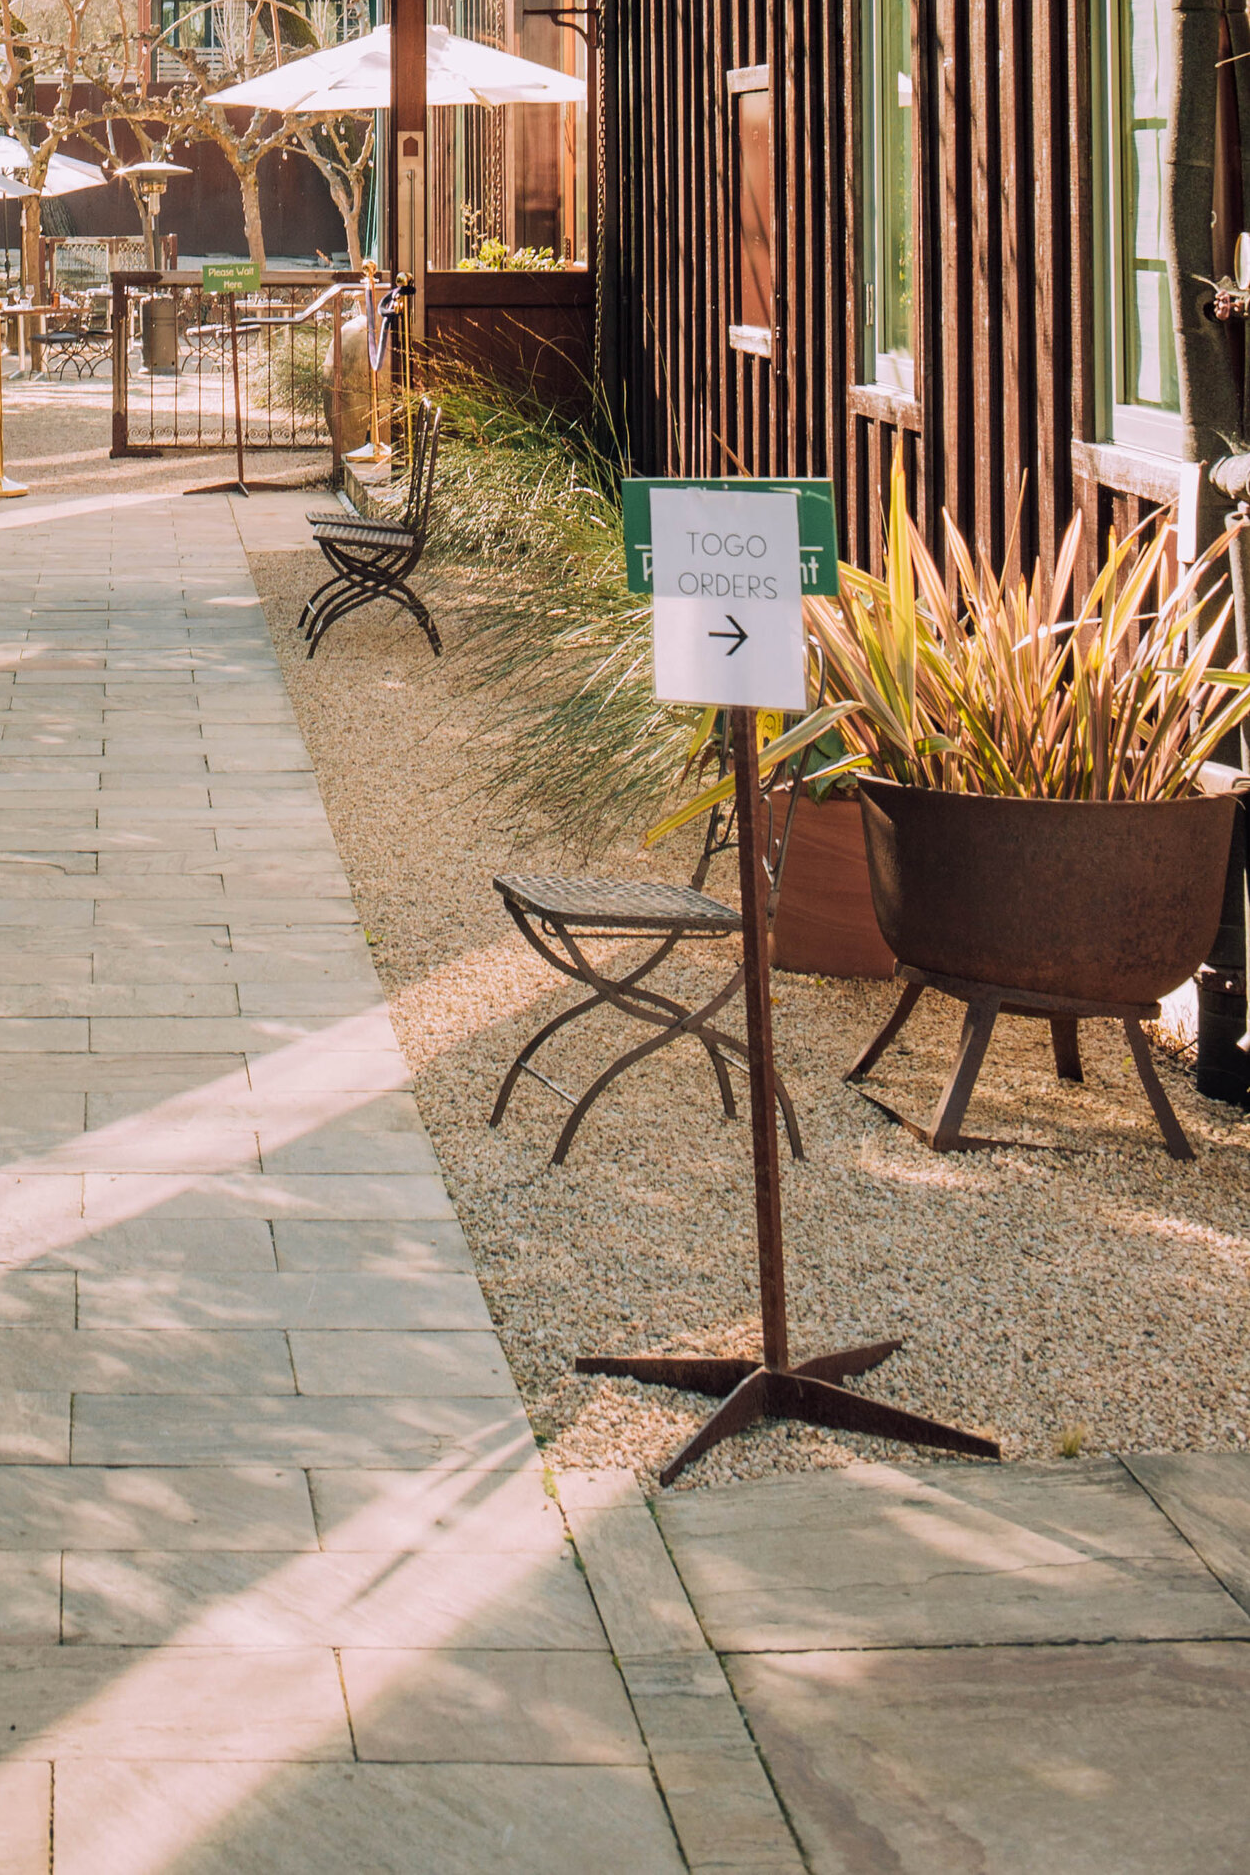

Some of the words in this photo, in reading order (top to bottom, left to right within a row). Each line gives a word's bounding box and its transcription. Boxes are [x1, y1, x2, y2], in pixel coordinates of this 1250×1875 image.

[208, 268, 234, 277] Please
[236, 266, 254, 276] Wait
[223, 280, 243, 289] Here
[686, 532, 767, 559] TOGO
[678, 572, 778, 600] ORDERS
